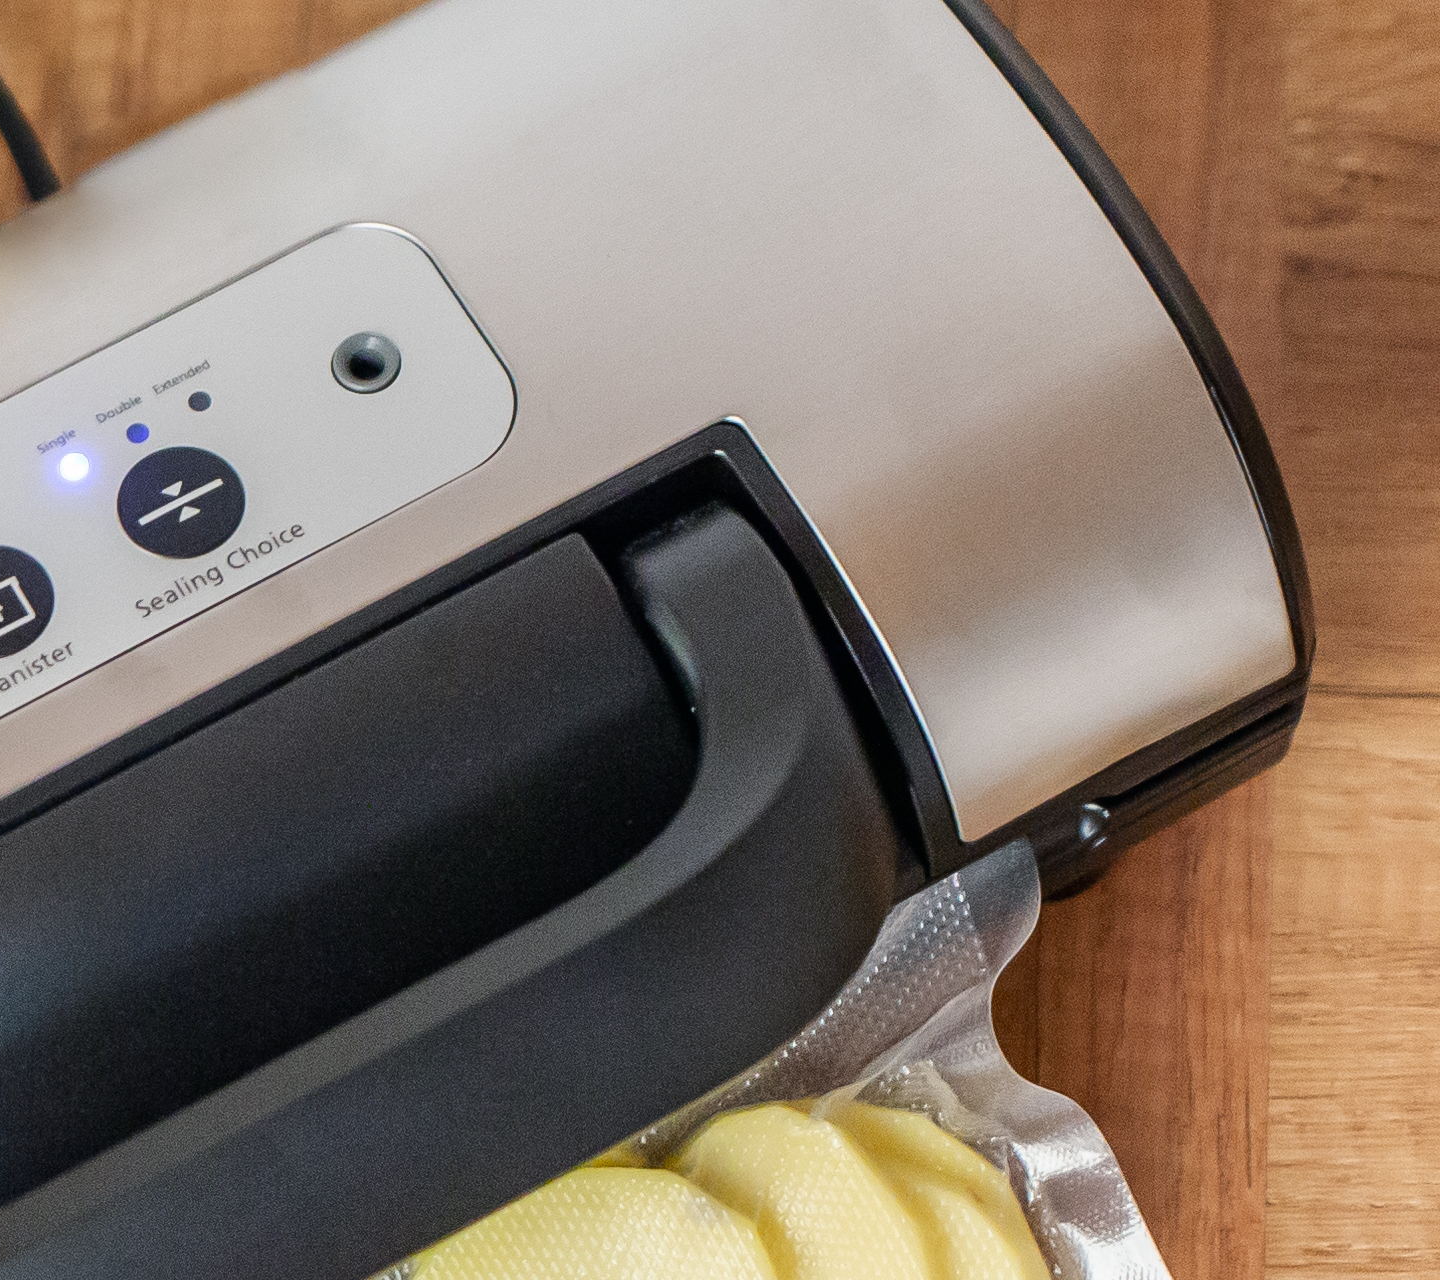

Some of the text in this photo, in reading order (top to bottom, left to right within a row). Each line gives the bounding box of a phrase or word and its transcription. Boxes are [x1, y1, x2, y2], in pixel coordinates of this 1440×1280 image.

[151, 359, 211, 396] Extended
[95, 395, 142, 424] Double
[36, 428, 77, 455] Single
[135, 523, 306, 619] Sealing Choice
